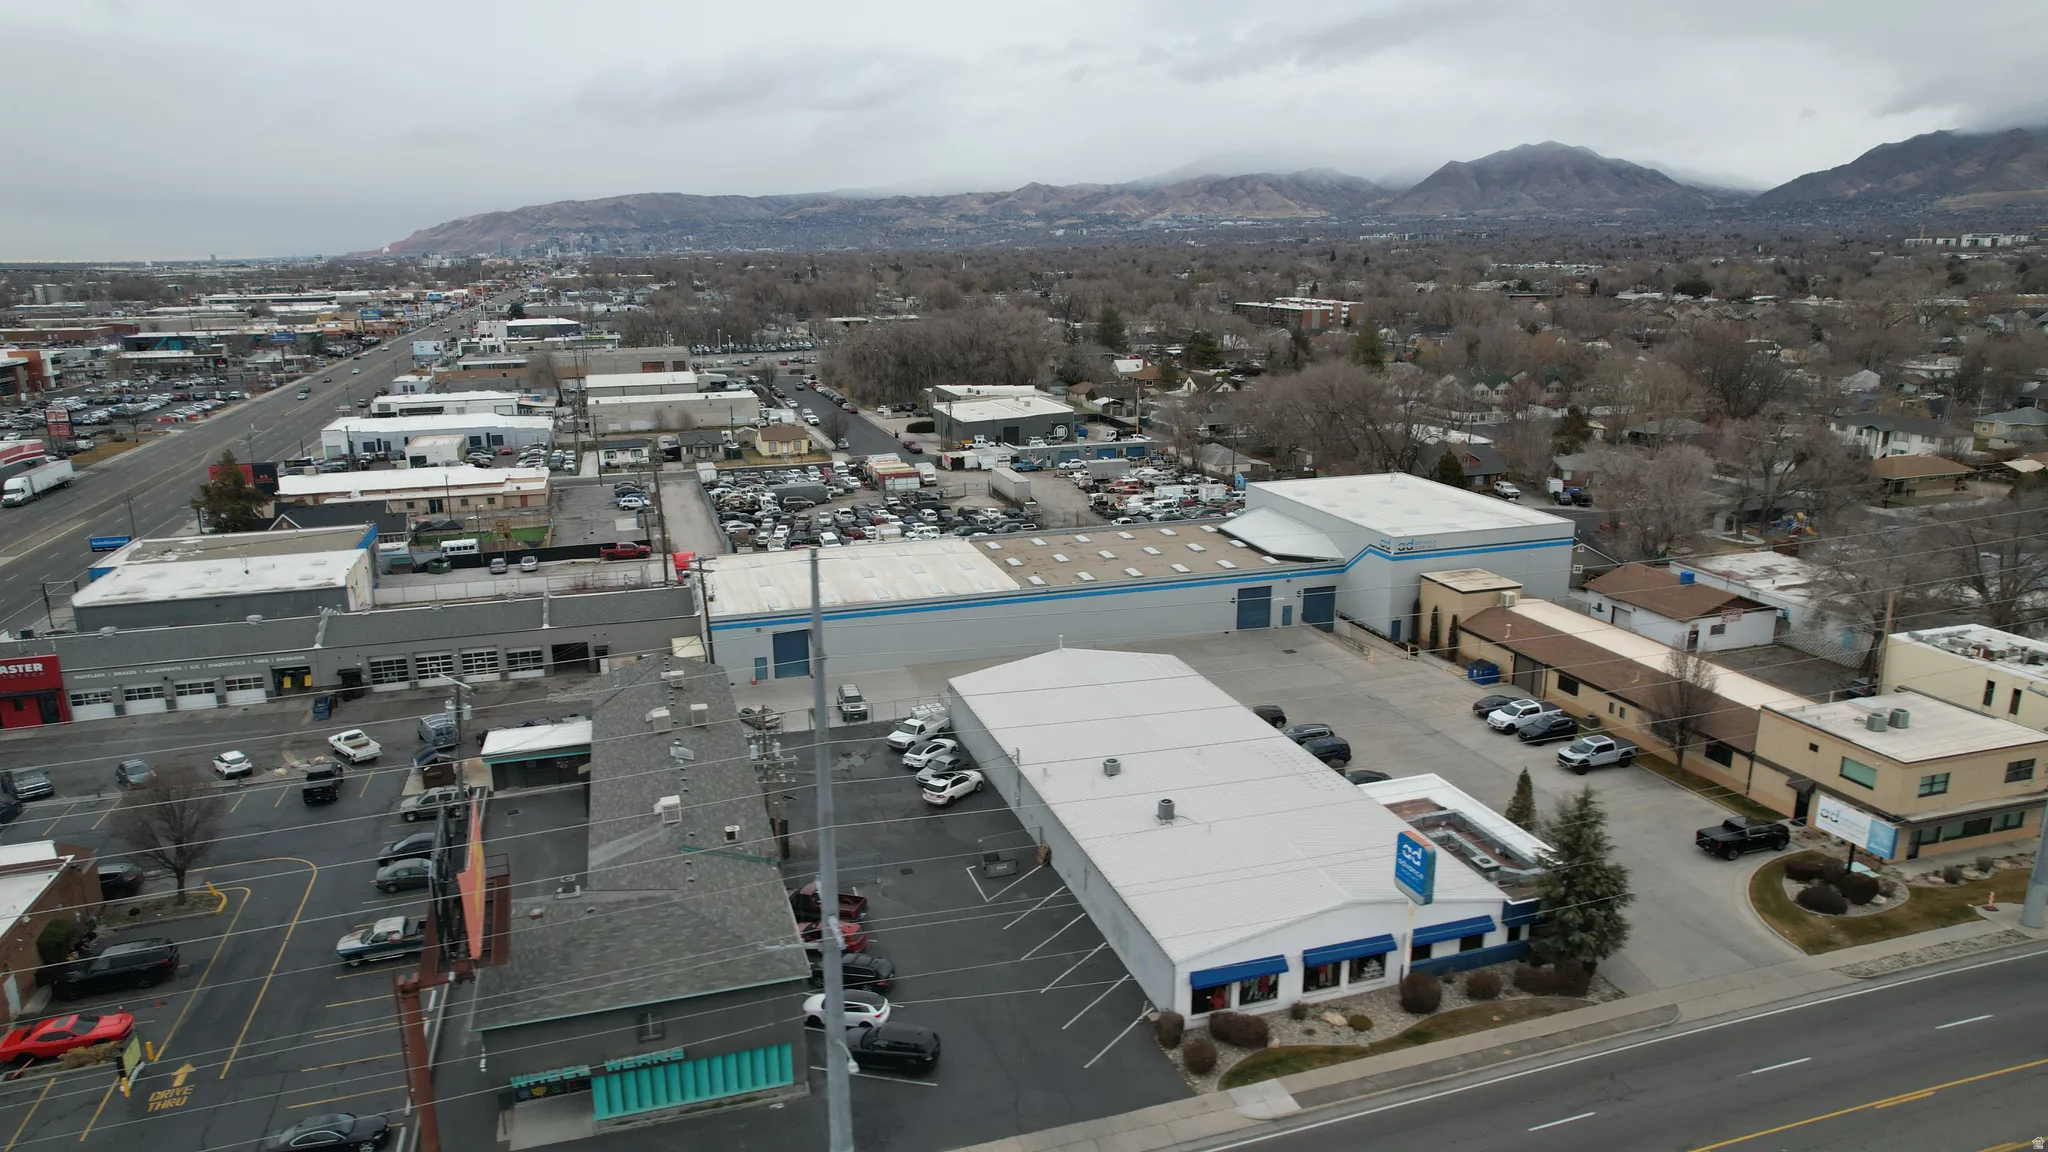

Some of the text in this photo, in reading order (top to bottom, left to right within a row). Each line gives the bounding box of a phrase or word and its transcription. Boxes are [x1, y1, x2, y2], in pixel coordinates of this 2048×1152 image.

[1398, 538, 1414, 551] ad
[0, 663, 43, 674] ASTER
[145, 666, 182, 674] ALIGNMENTS
[208, 660, 246, 668] DIAGNOSTICS
[148, 1084, 196, 1103] DRIVE
[147, 1096, 188, 1112] THRU
